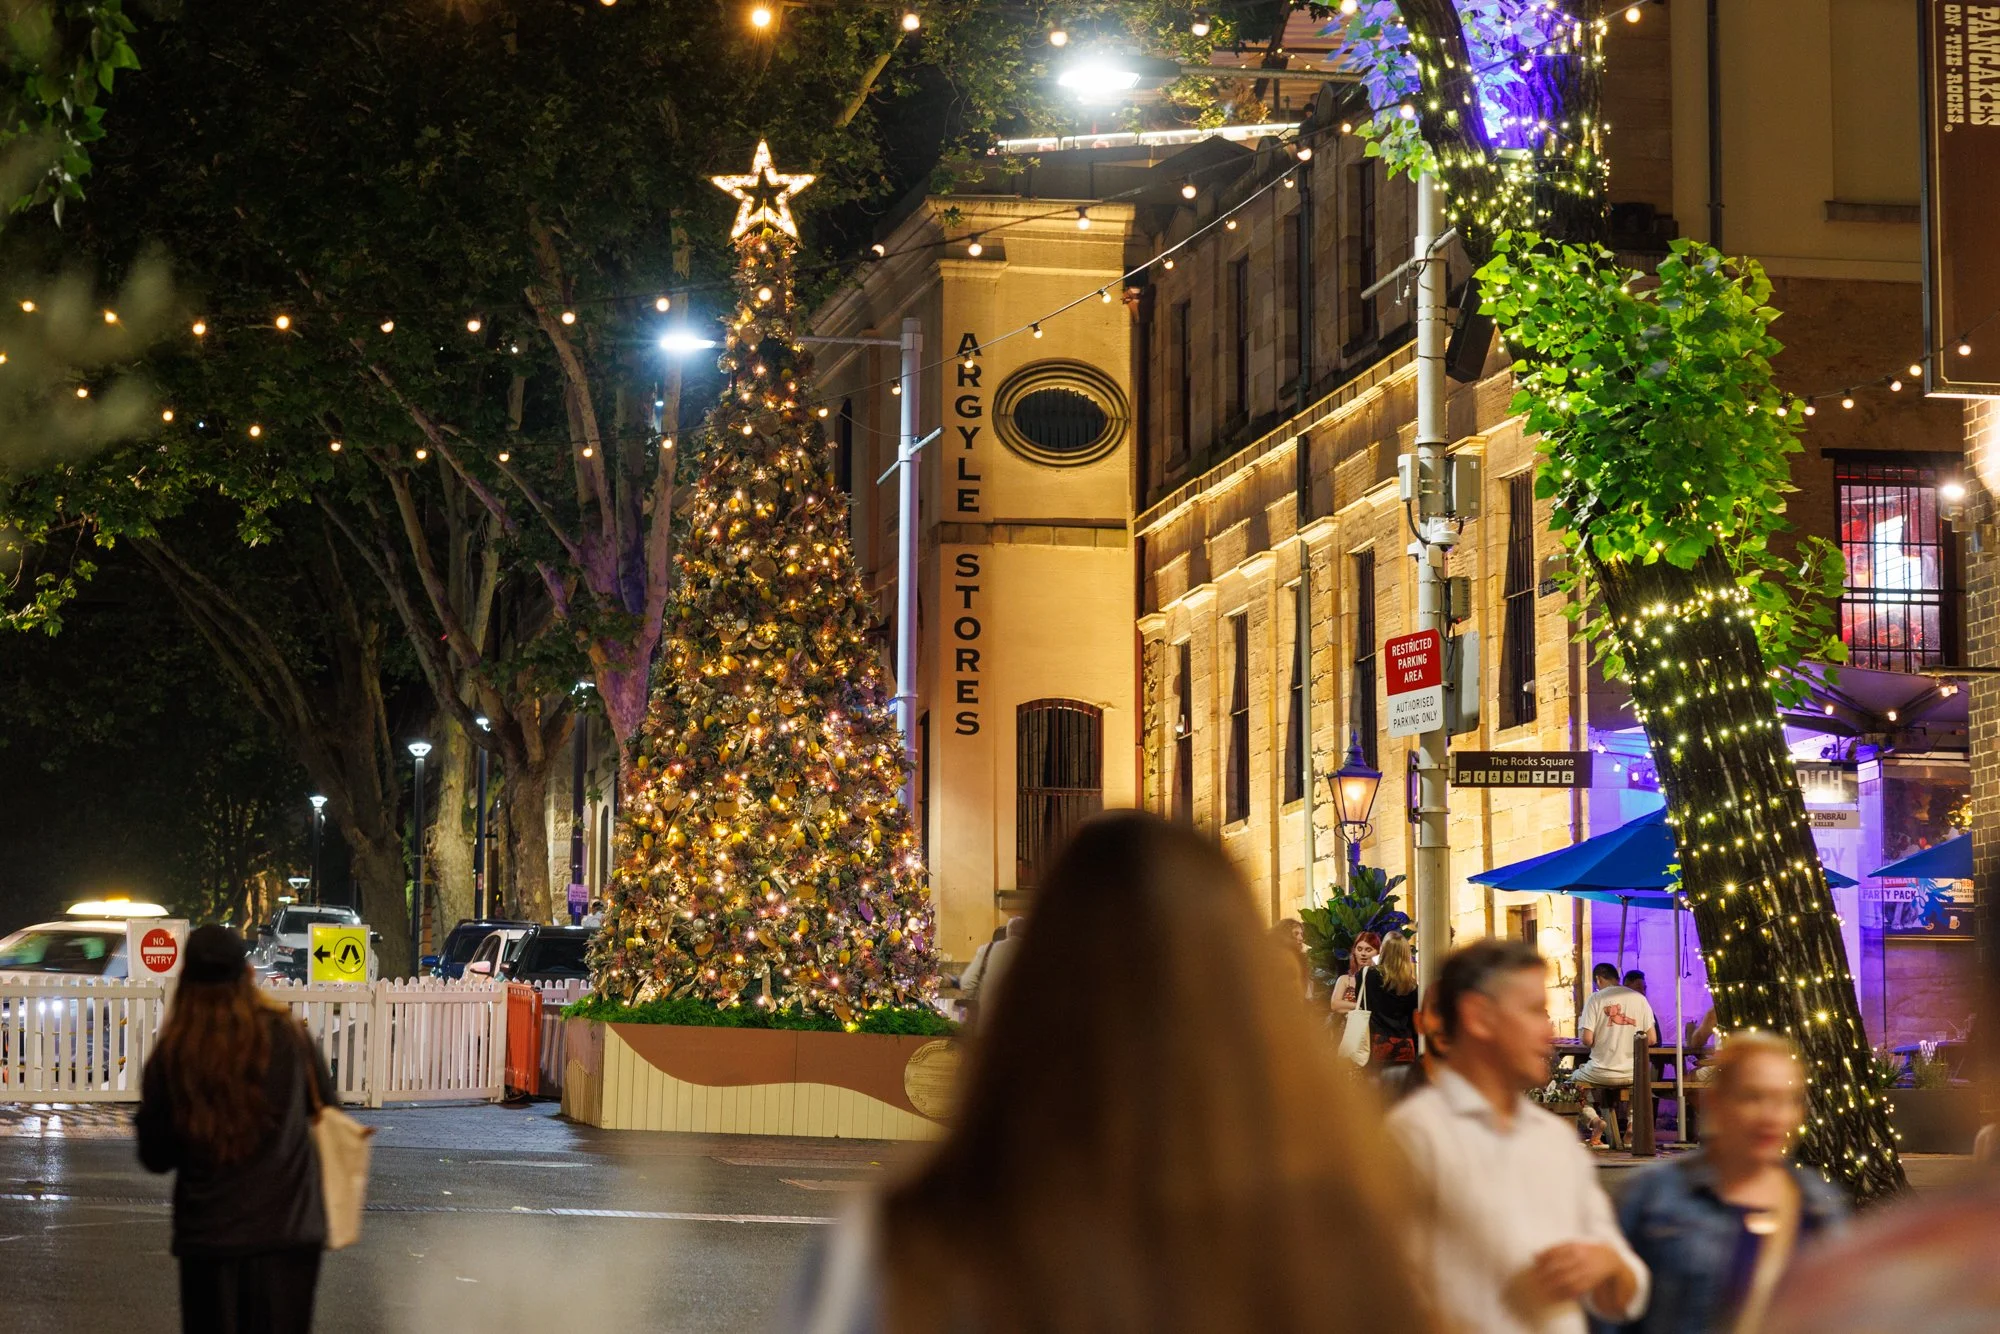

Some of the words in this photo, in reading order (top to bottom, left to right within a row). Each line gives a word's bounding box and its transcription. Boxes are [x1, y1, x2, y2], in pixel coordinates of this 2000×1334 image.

[1945, 5, 1961, 26] ON
[1945, 34, 1962, 66] THE
[1967, 5, 2000, 125] PANCAKES
[1946, 74, 1964, 123] ROCKS
[955, 333, 982, 512] ARGYLE
[954, 553, 981, 735] STORES
[1391, 637, 1432, 656] RESTRICTED
[1398, 653, 1427, 670] PARKING
[1404, 669, 1423, 683] AREA
[1396, 695, 1434, 713] AUTHORISED
[1393, 714, 1419, 728] PARKING
[1422, 710, 1438, 723] ONLY
[1490, 756, 1508, 766] The
[1510, 756, 1538, 766] Rocks
[1540, 756, 1574, 769] Square
[153, 937, 164, 945] NO
[146, 956, 172, 964] ENTRY
